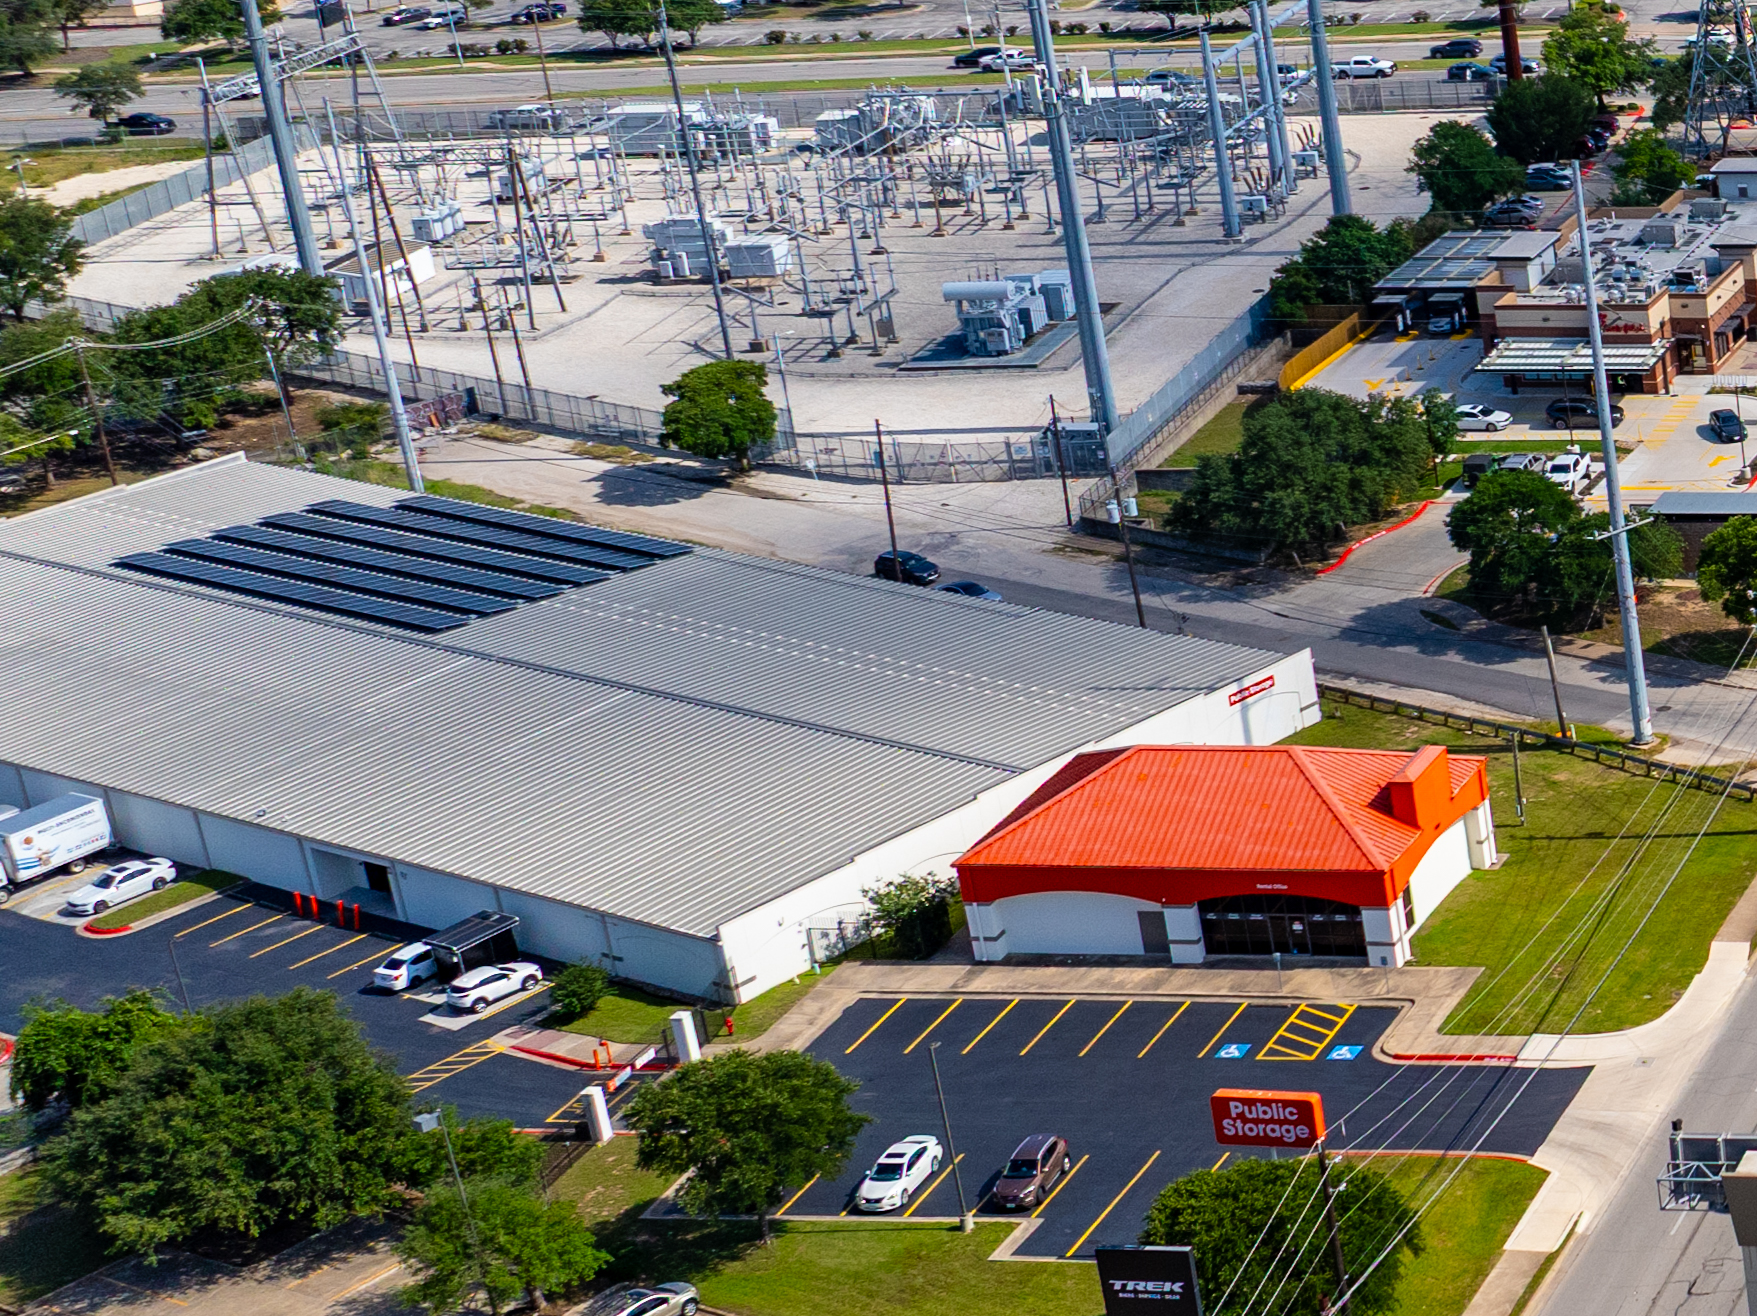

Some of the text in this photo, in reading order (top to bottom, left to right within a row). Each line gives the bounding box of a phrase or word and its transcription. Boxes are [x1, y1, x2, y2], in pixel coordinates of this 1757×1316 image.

[1229, 1102, 1298, 1121] Public
[1222, 1119, 1310, 1142] Storage
[1108, 1279, 1185, 1293] TREK
